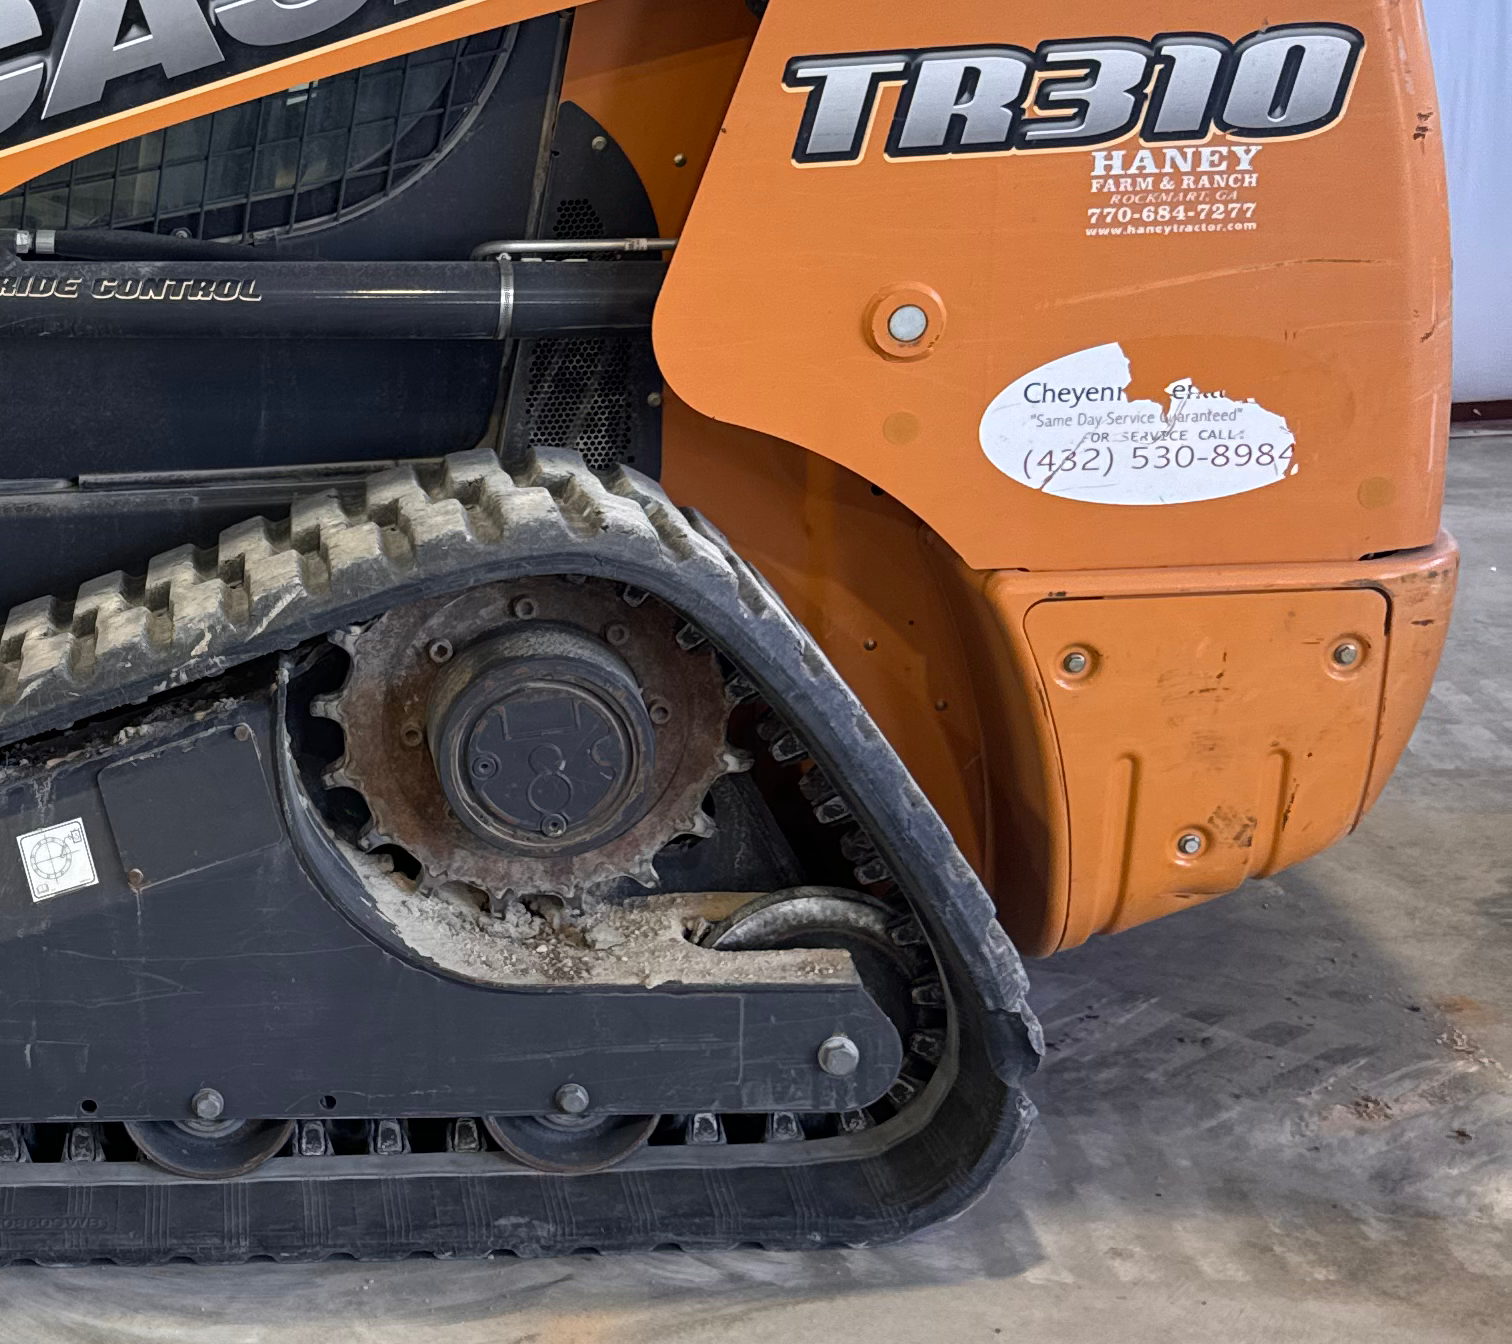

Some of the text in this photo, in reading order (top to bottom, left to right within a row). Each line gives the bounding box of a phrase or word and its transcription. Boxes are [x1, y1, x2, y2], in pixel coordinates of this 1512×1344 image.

[788, 27, 1358, 161] TR310
[1090, 145, 1263, 176] HANEY
[1090, 173, 1258, 192] FARM & RANCH
[1215, 189, 1238, 201] GA
[1088, 202, 1257, 224] 770-684-7277
[1085, 221, 1257, 236] www.haneytractor.com
[91, 277, 262, 301] CONTROL
[1030, 414, 1072, 428] "Same
[1078, 412, 1102, 429] Day
[1106, 411, 1155, 425] Service
[1122, 430, 1188, 443] SERVICE
[1023, 443, 1294, 480] (432) 530-8984
